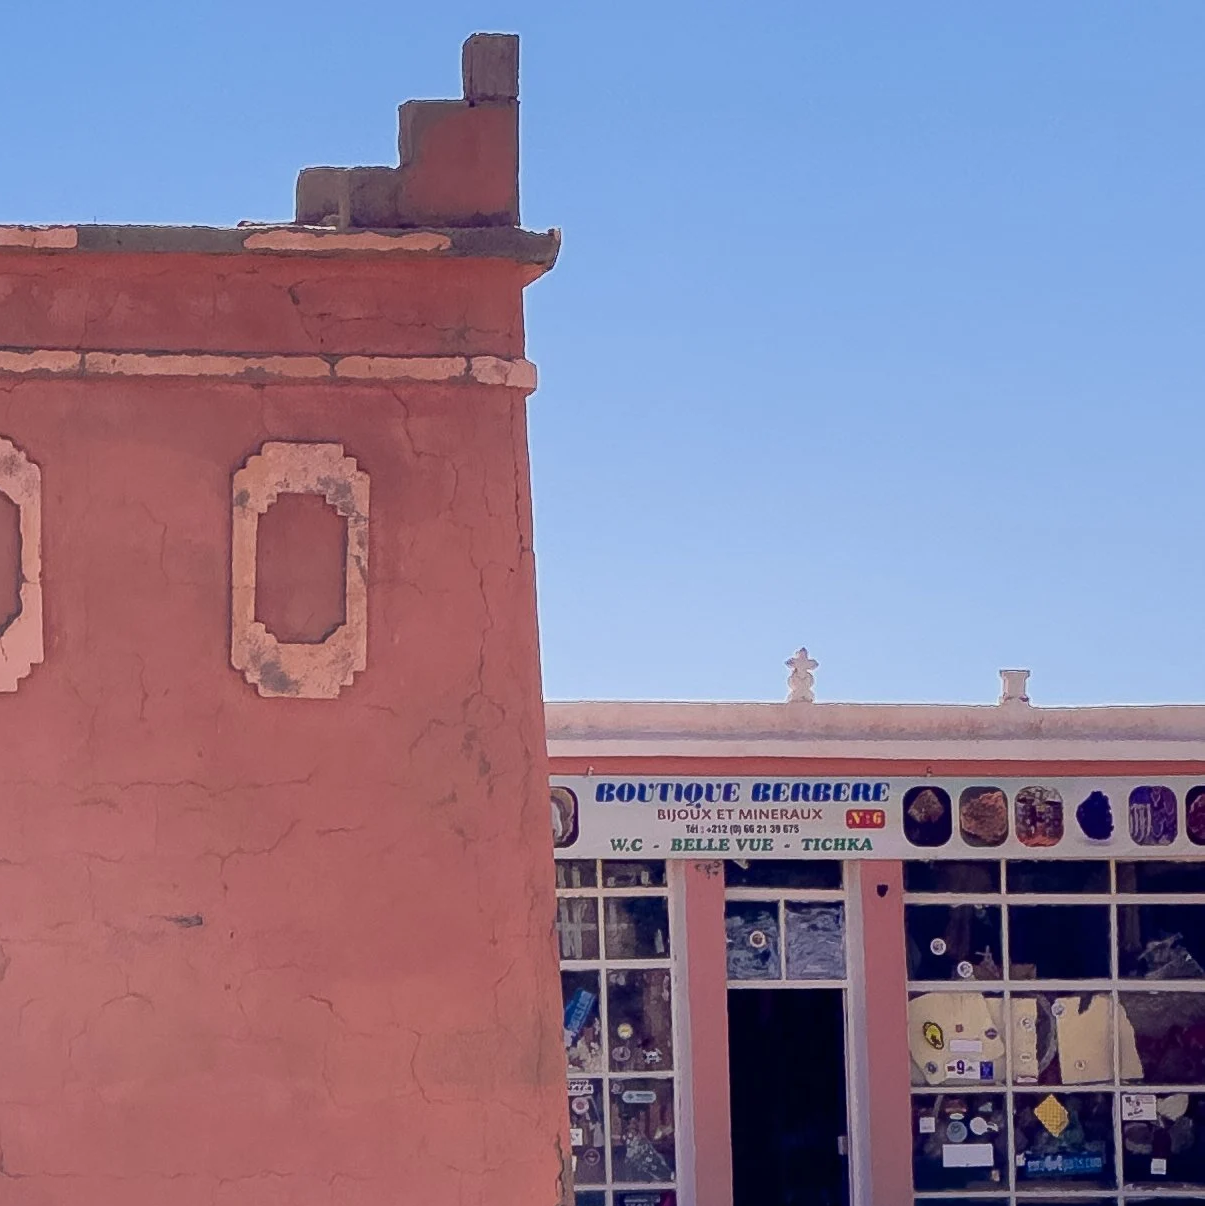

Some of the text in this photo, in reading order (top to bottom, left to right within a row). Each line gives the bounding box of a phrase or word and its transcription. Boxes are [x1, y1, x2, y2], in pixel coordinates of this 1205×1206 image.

[595, 782, 890, 809] BOUTIQUE BERBERE
[657, 809, 823, 822] BIJOUX ET MINERAUX
[757, 824, 767, 833] 21
[670, 838, 730, 851] BELLE
[736, 838, 774, 851] VUE
[802, 839, 873, 851] TICHKA
